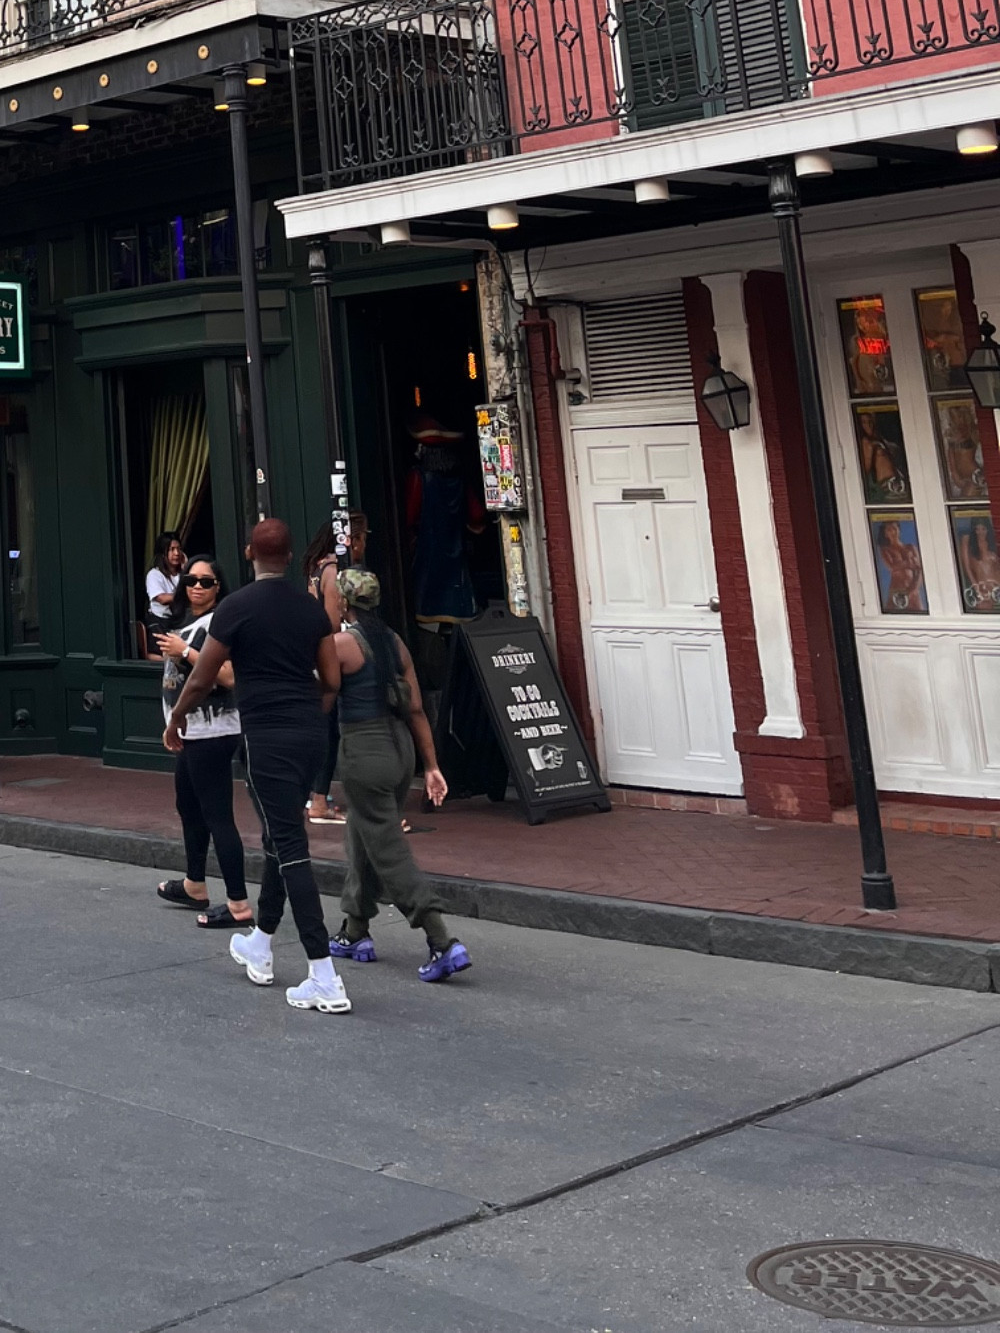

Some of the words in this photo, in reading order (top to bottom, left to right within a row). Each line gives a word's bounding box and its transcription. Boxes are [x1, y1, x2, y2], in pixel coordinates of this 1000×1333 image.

[491, 652, 537, 668] DRINKERY
[507, 700, 561, 722] COCKTAILS
[790, 1268, 988, 1302] WATER
